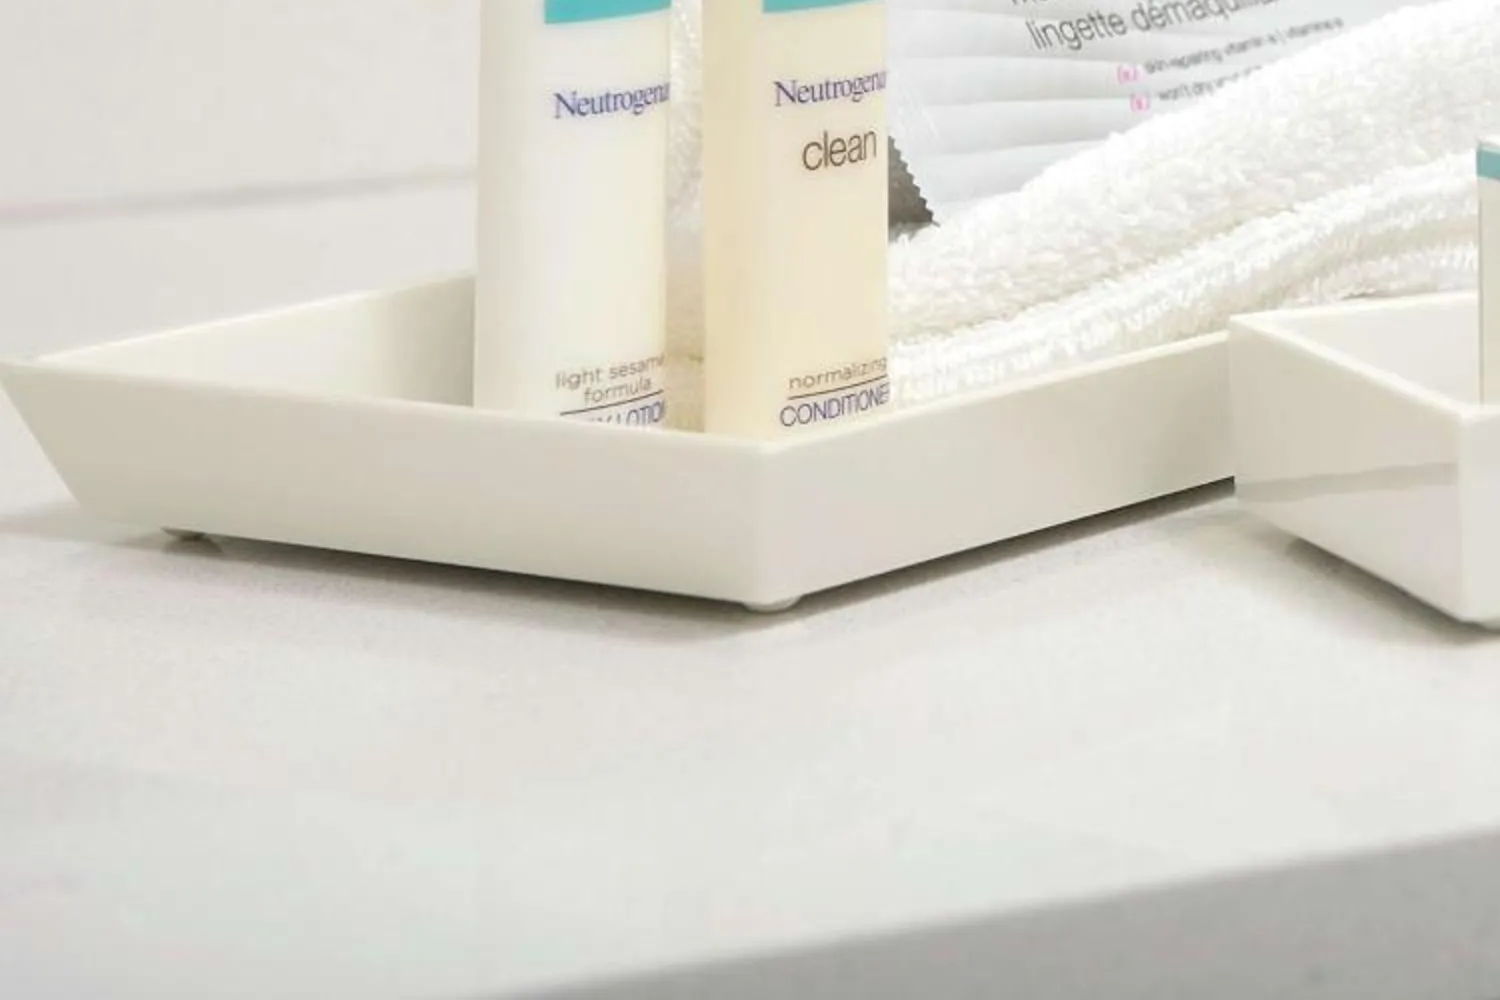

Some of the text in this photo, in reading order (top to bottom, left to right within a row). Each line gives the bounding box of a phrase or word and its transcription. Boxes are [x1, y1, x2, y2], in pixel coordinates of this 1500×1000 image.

[1025, 9, 1128, 51] lingette
[802, 129, 877, 171] clean
[555, 354, 665, 391] light sesam
[583, 376, 652, 403] formula
[788, 357, 887, 389] normalizing
[779, 381, 891, 427] CONDITIONE
